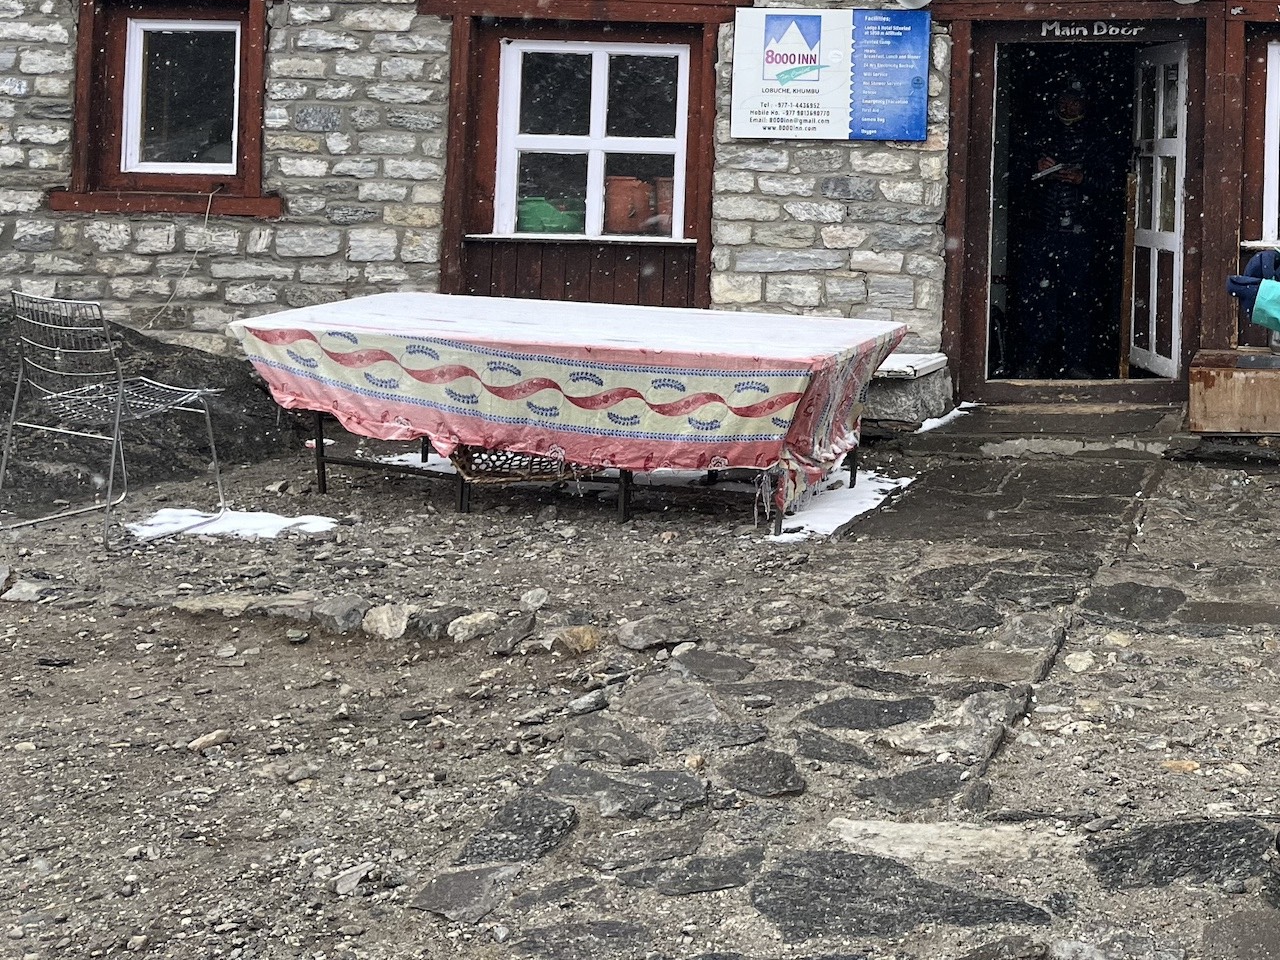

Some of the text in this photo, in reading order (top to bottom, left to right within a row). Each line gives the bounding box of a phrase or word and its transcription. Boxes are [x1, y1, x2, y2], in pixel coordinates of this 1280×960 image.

[1041, 21, 1145, 36] Main Door
[765, 49, 817, 64] 8000 INN
